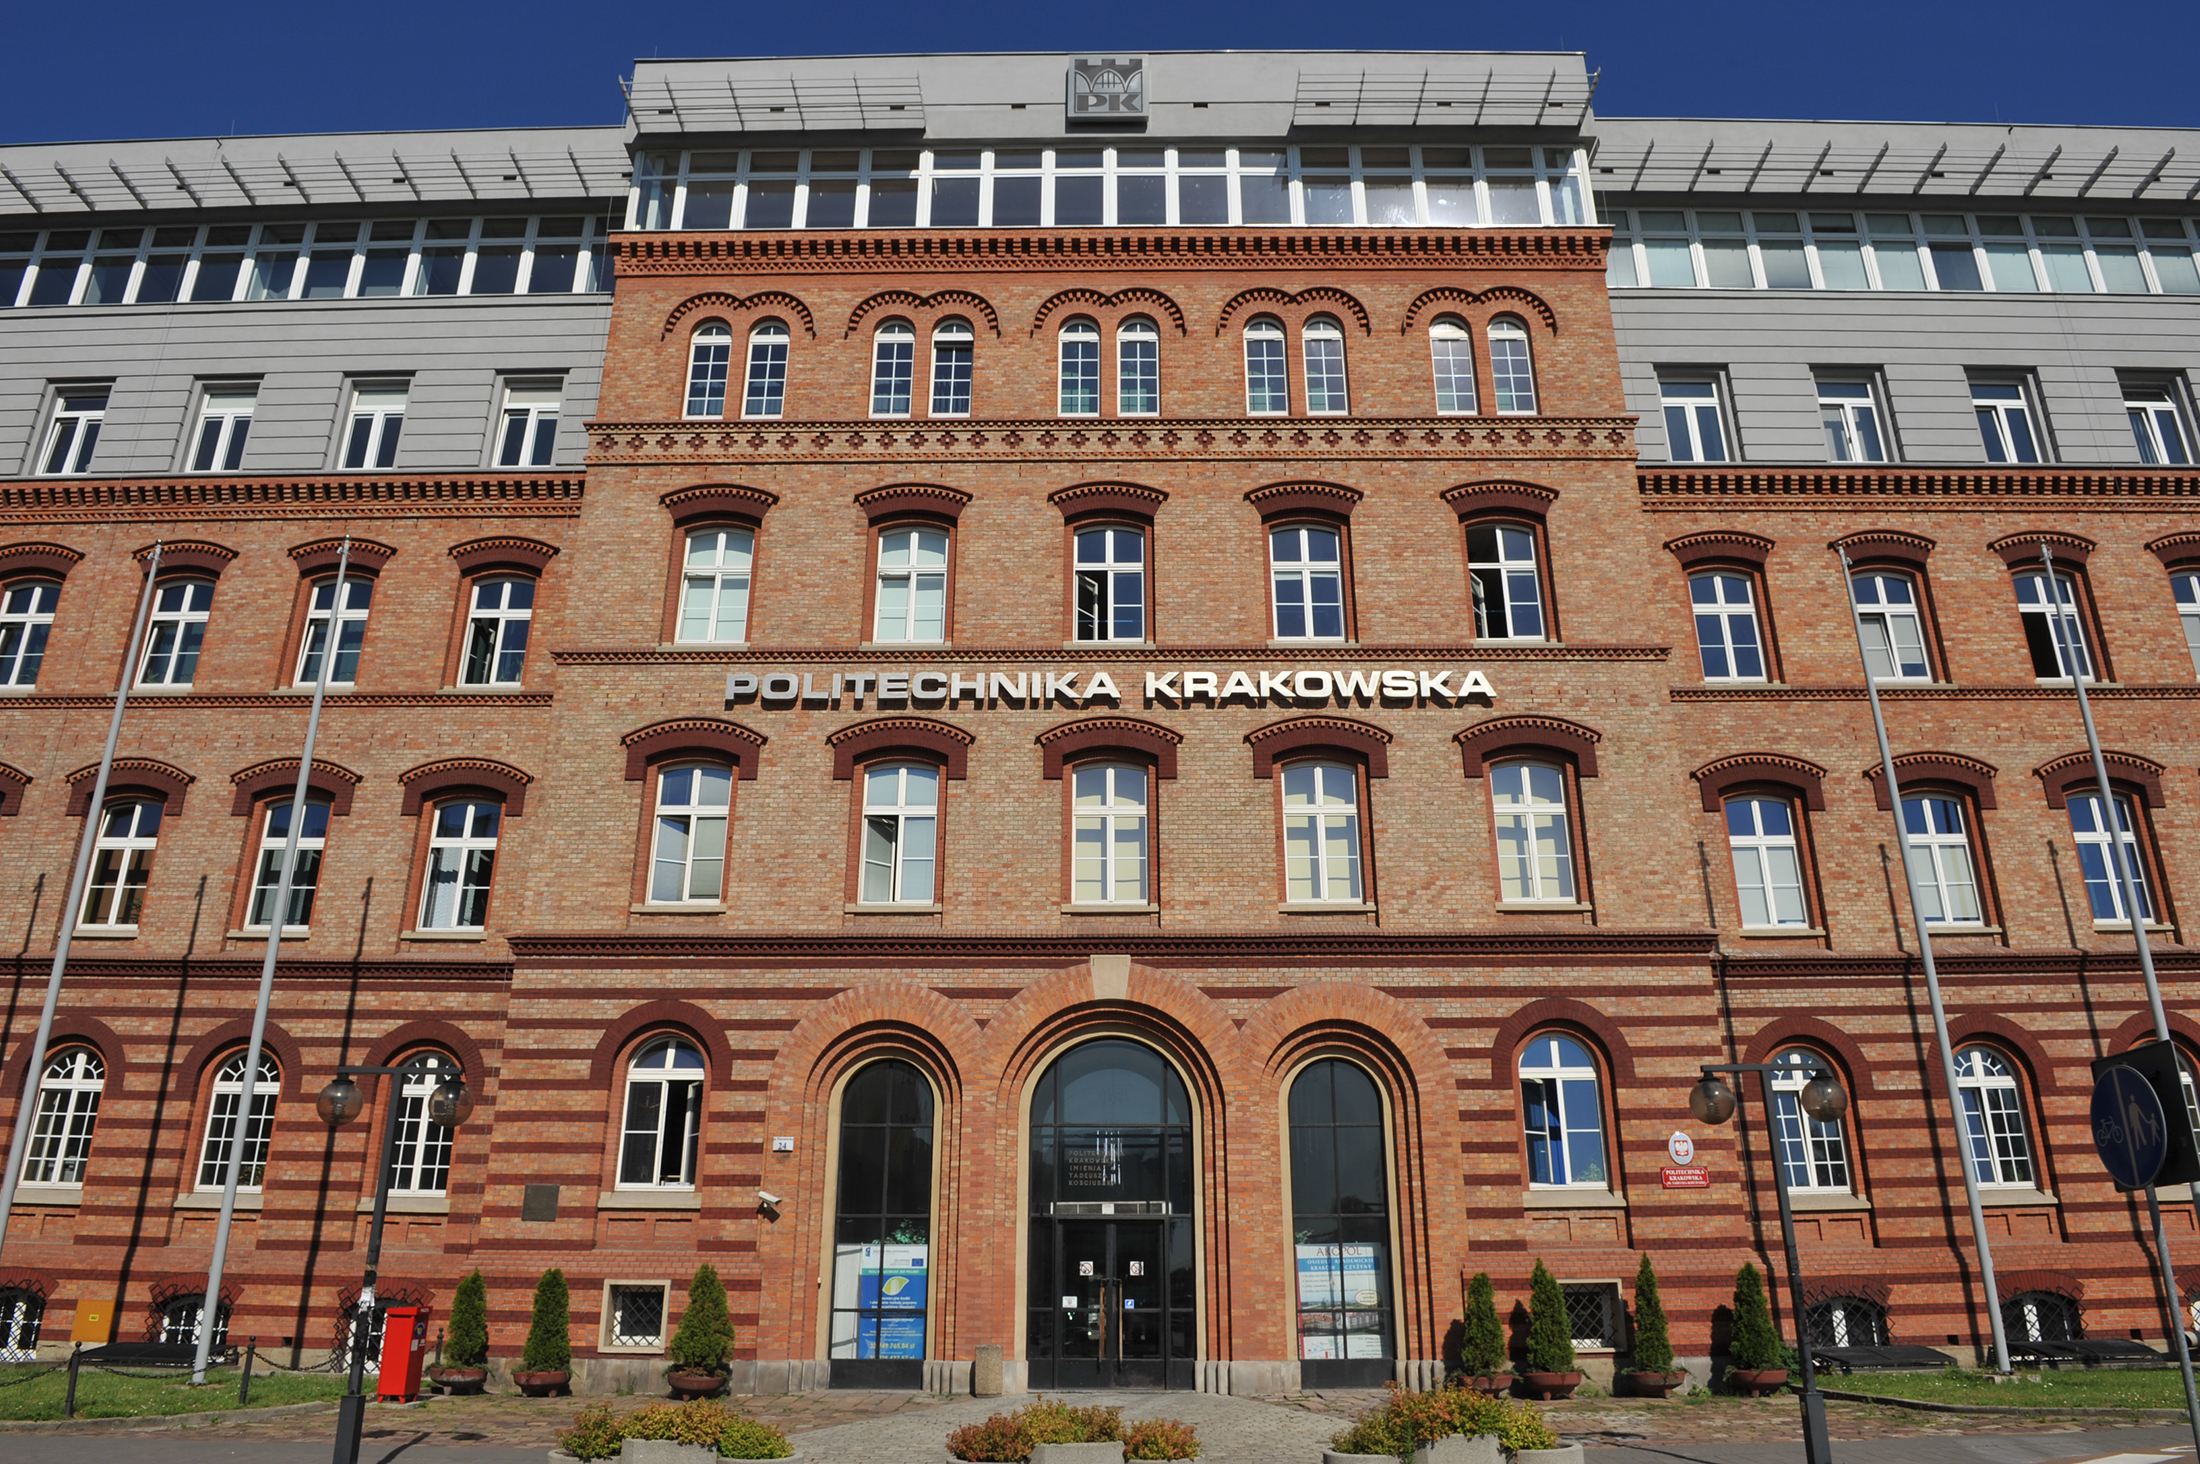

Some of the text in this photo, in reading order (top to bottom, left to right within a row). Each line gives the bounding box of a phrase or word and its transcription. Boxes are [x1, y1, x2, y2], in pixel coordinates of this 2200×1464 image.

[1077, 94, 1140, 111] PK
[725, 671, 1498, 700] POLITECHNIKA KRAKOWSKA
[778, 1142, 787, 1150] 24
